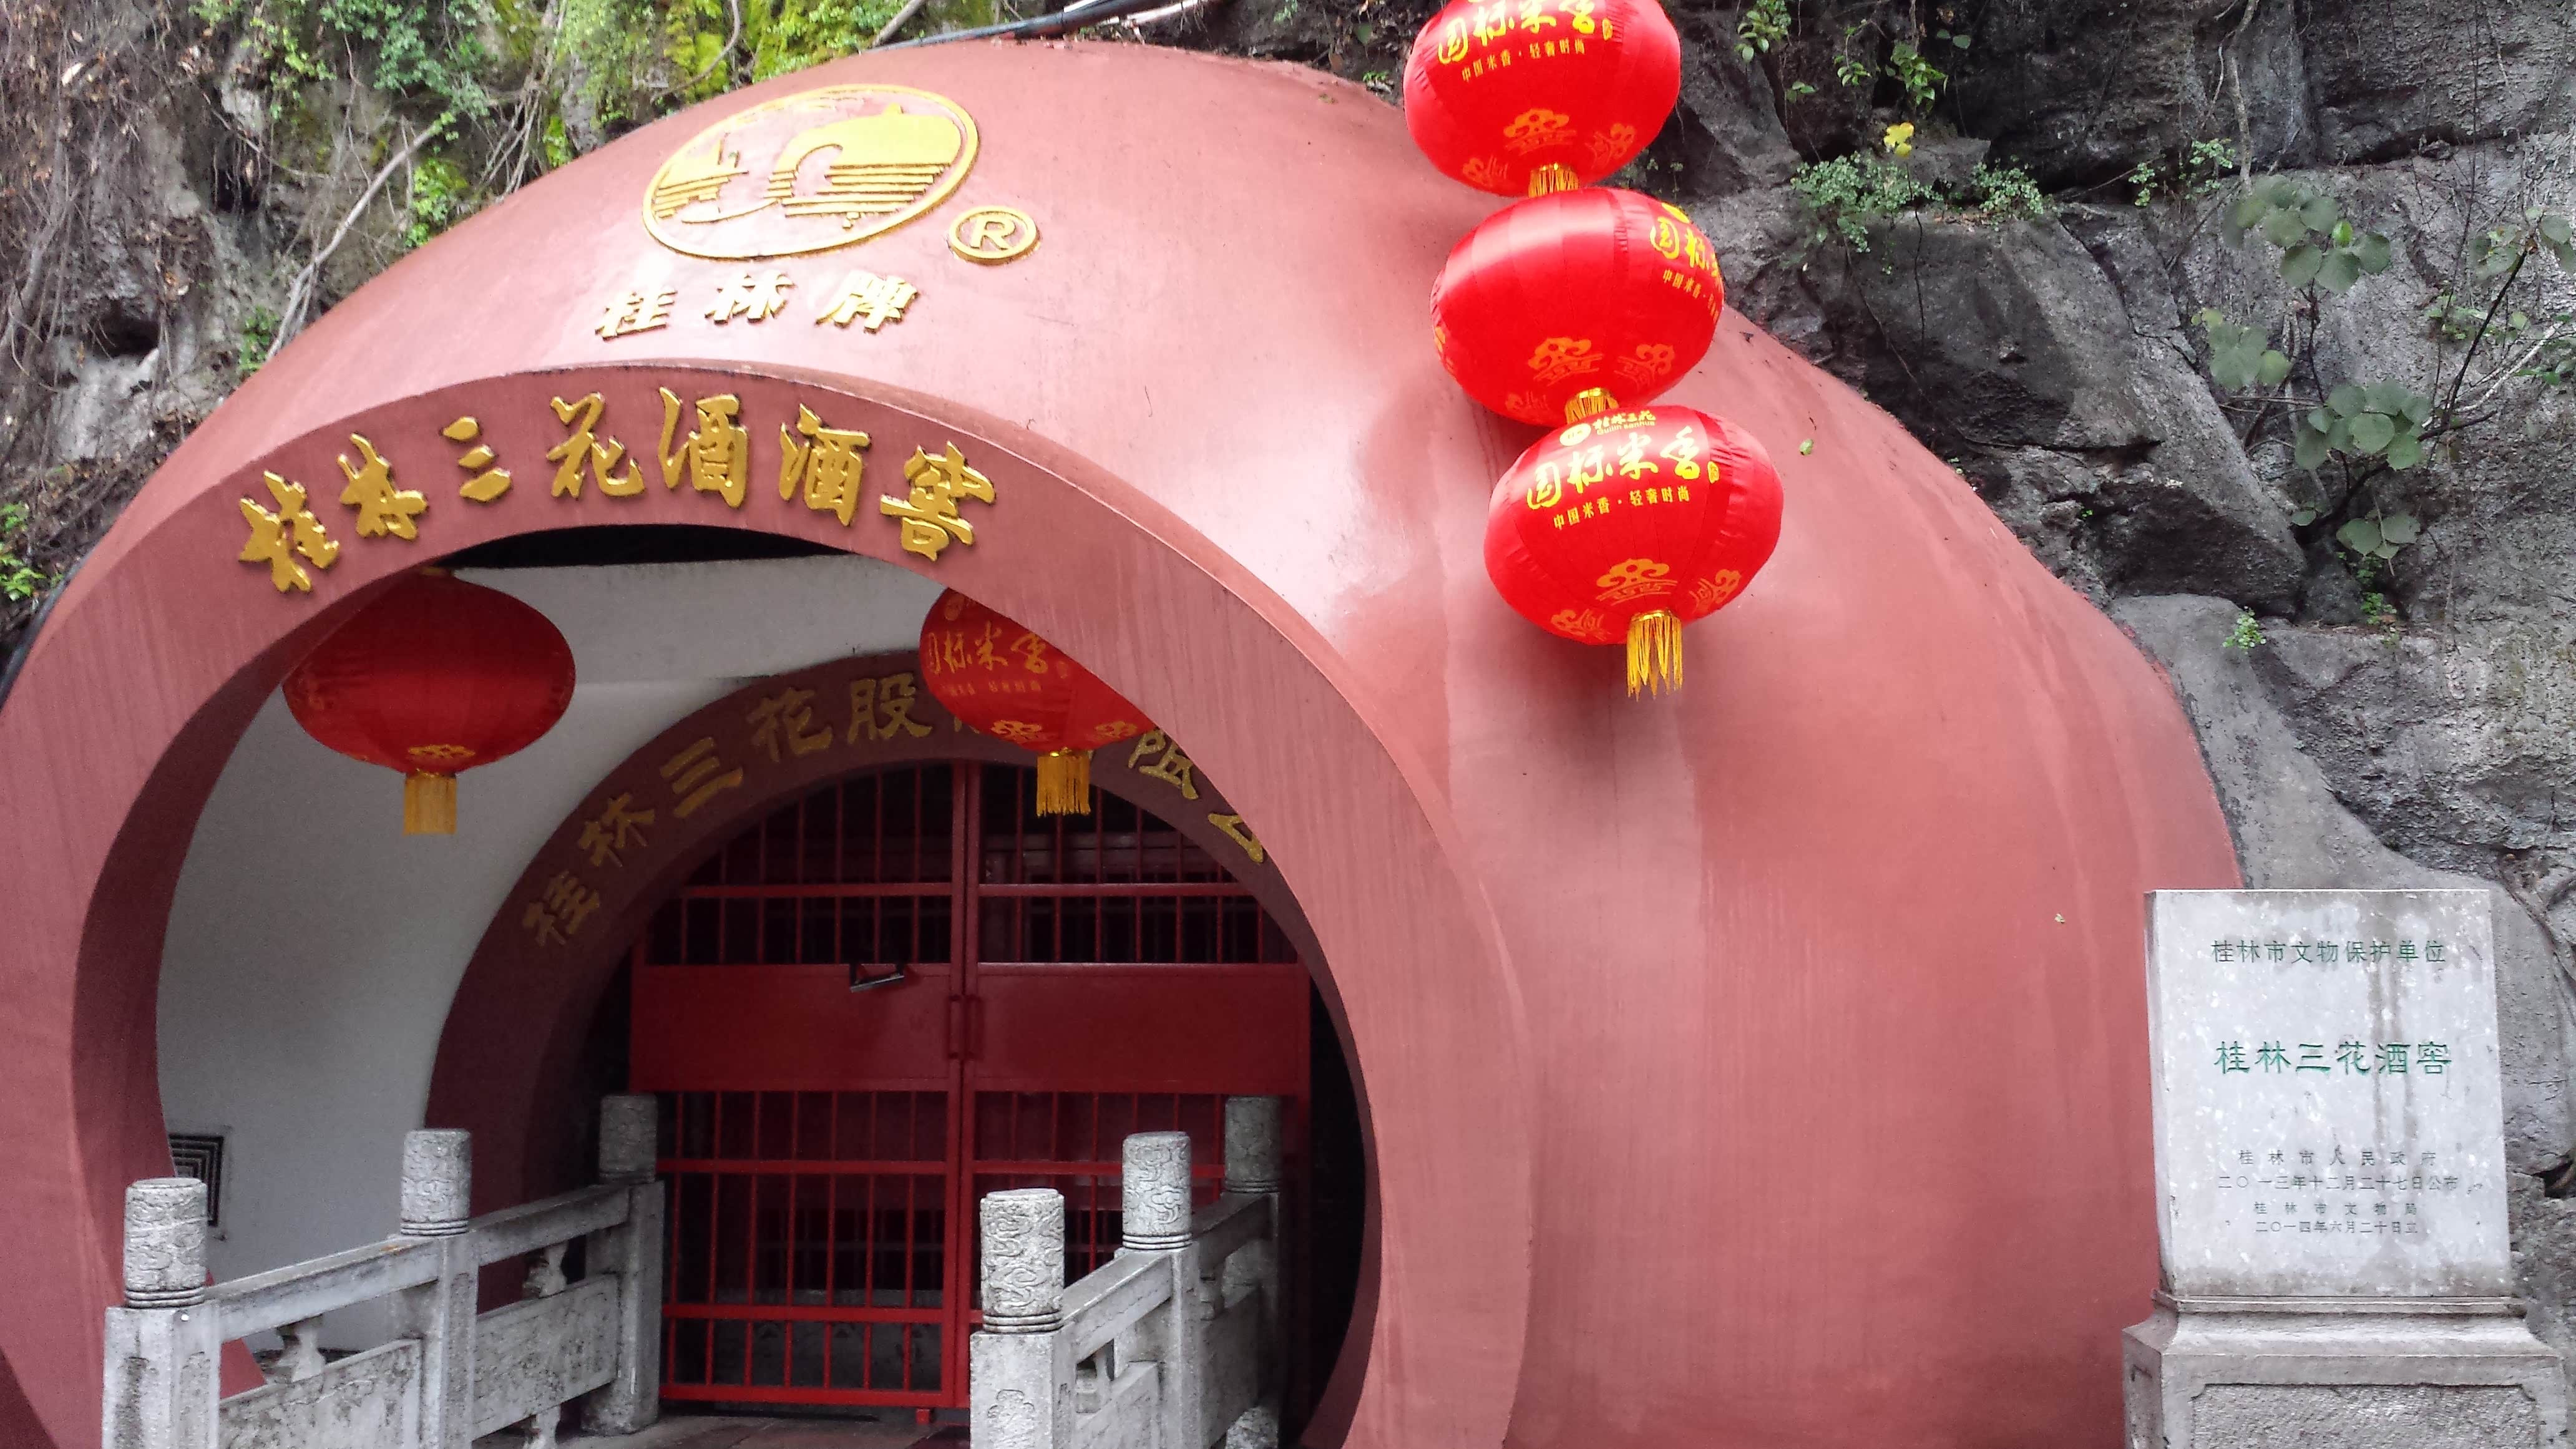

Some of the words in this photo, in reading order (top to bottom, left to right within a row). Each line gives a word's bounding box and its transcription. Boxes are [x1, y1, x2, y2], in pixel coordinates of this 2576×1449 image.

[595, 270, 920, 340] 桂林牌
[1553, 485, 1690, 530] 中国米香·轻奢时尚
[2210, 940, 2446, 964] 桂林市文物保护单位
[2213, 1040, 2452, 1075] 桂林三花酒窖
[2238, 1144, 2436, 1166] 桂林市人民政府
[2254, 1201, 2417, 1216] 桂林市文物局
